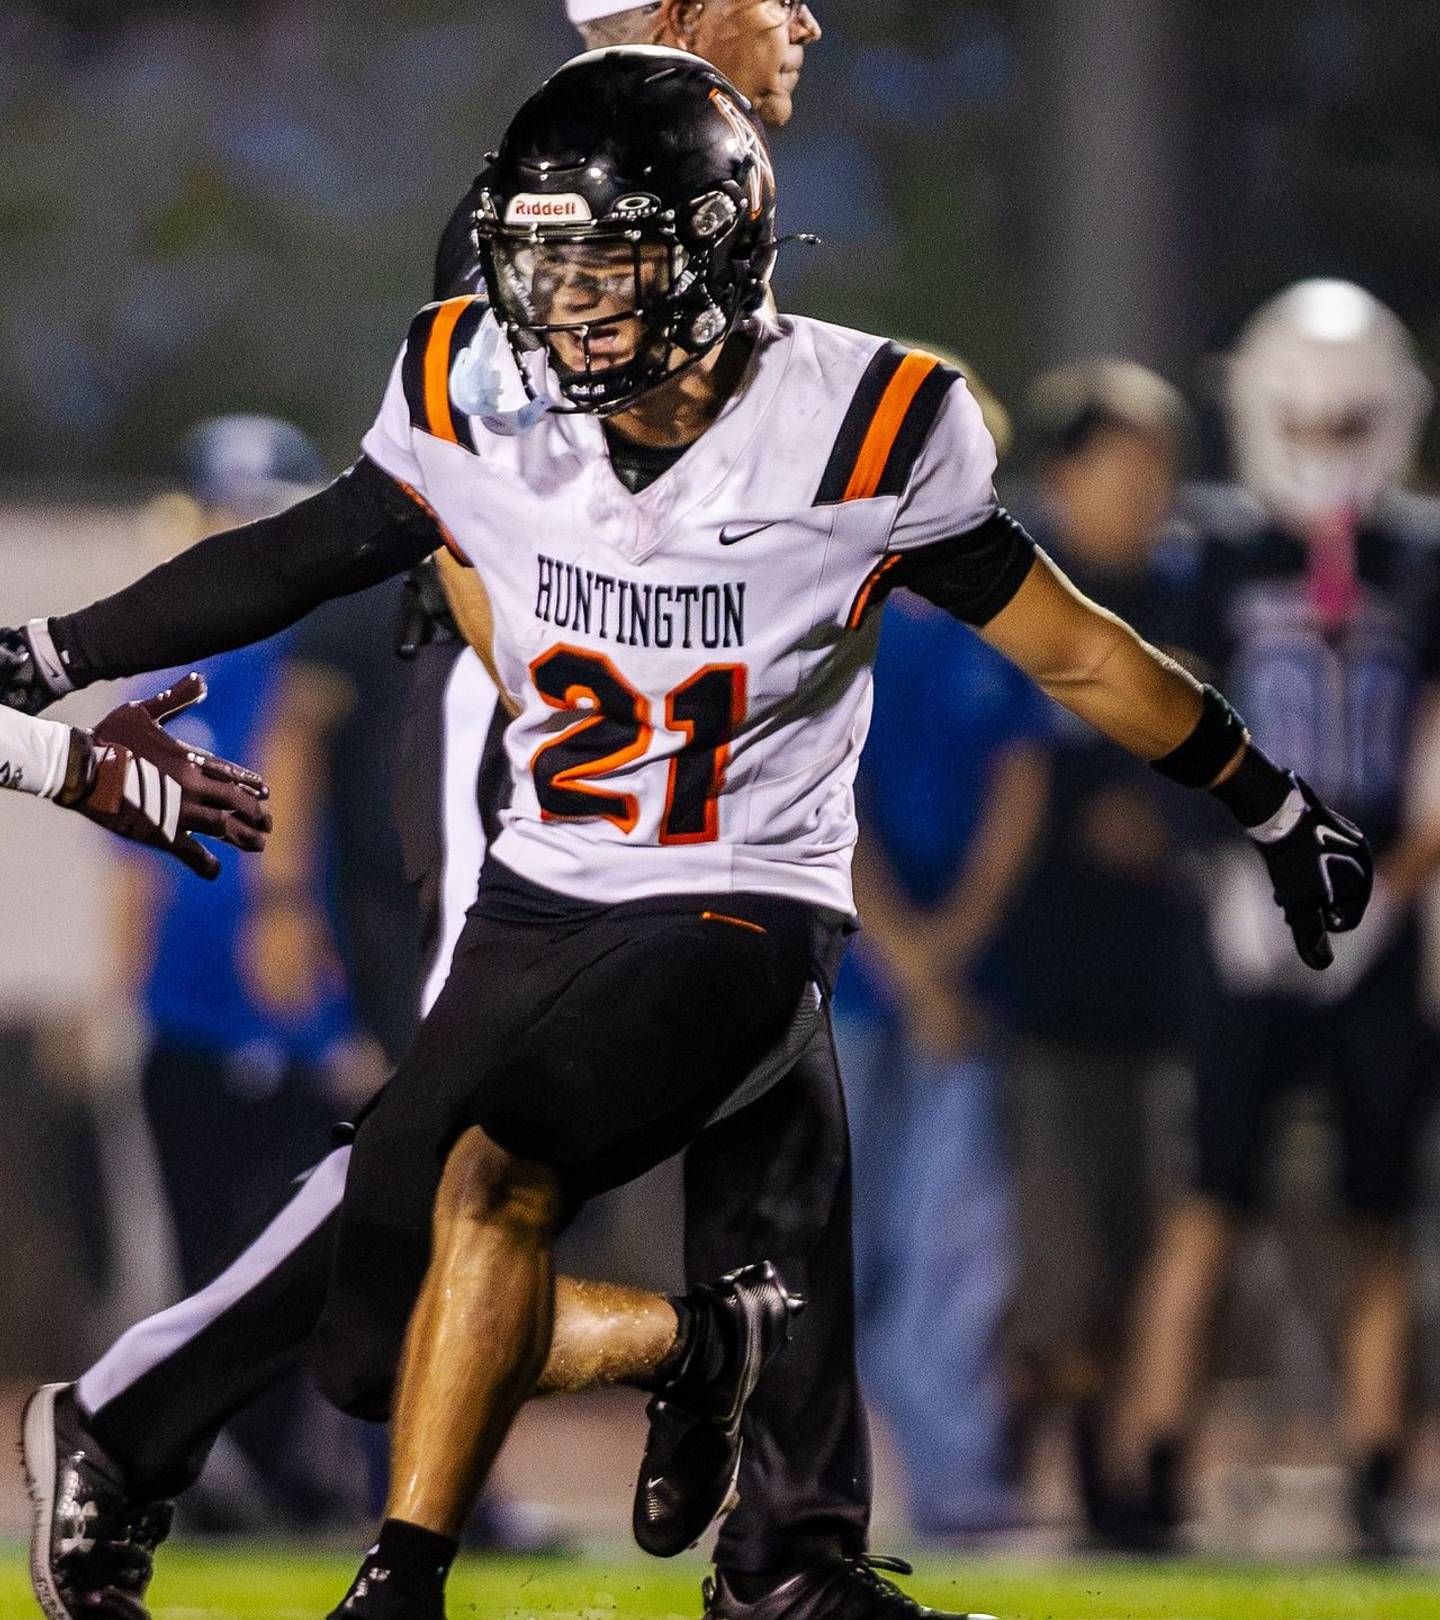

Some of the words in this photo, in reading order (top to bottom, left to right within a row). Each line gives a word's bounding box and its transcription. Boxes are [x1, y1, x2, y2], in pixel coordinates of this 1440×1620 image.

[515, 201, 576, 215] Riddell
[534, 553, 747, 650] HUNTINGTON
[529, 641, 749, 847] 21
